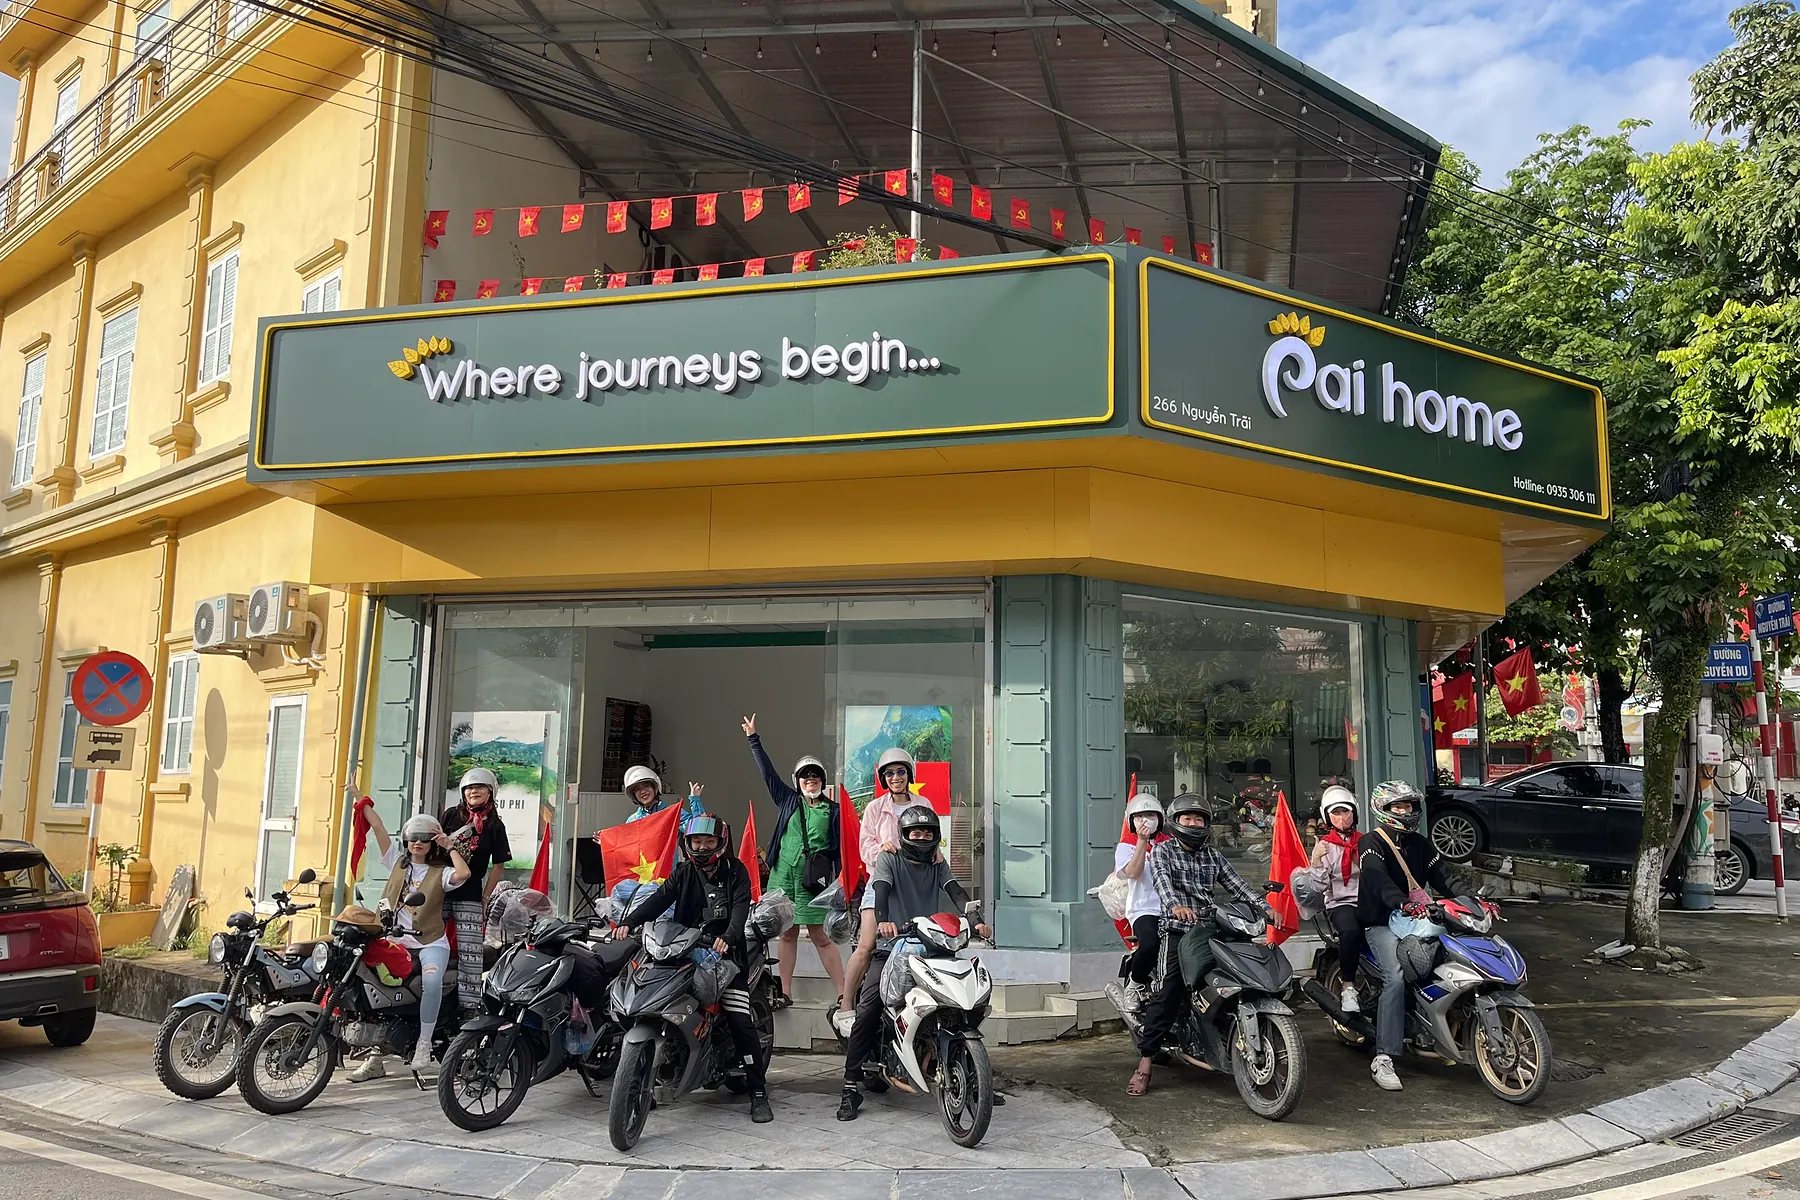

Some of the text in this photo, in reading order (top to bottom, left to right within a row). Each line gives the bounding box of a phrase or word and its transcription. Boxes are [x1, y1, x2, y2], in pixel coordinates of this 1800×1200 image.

[419, 330, 942, 402] Where journeys begin...
[1261, 336, 1524, 451] Pai home
[1153, 395, 1252, 430] 266 Nguyễn Trãi
[1513, 475, 1596, 505] Hotline: 0935 306 111
[1703, 662, 1748, 677] GUYỄN DU
[1713, 647, 1742, 660] ĐƯỜNG
